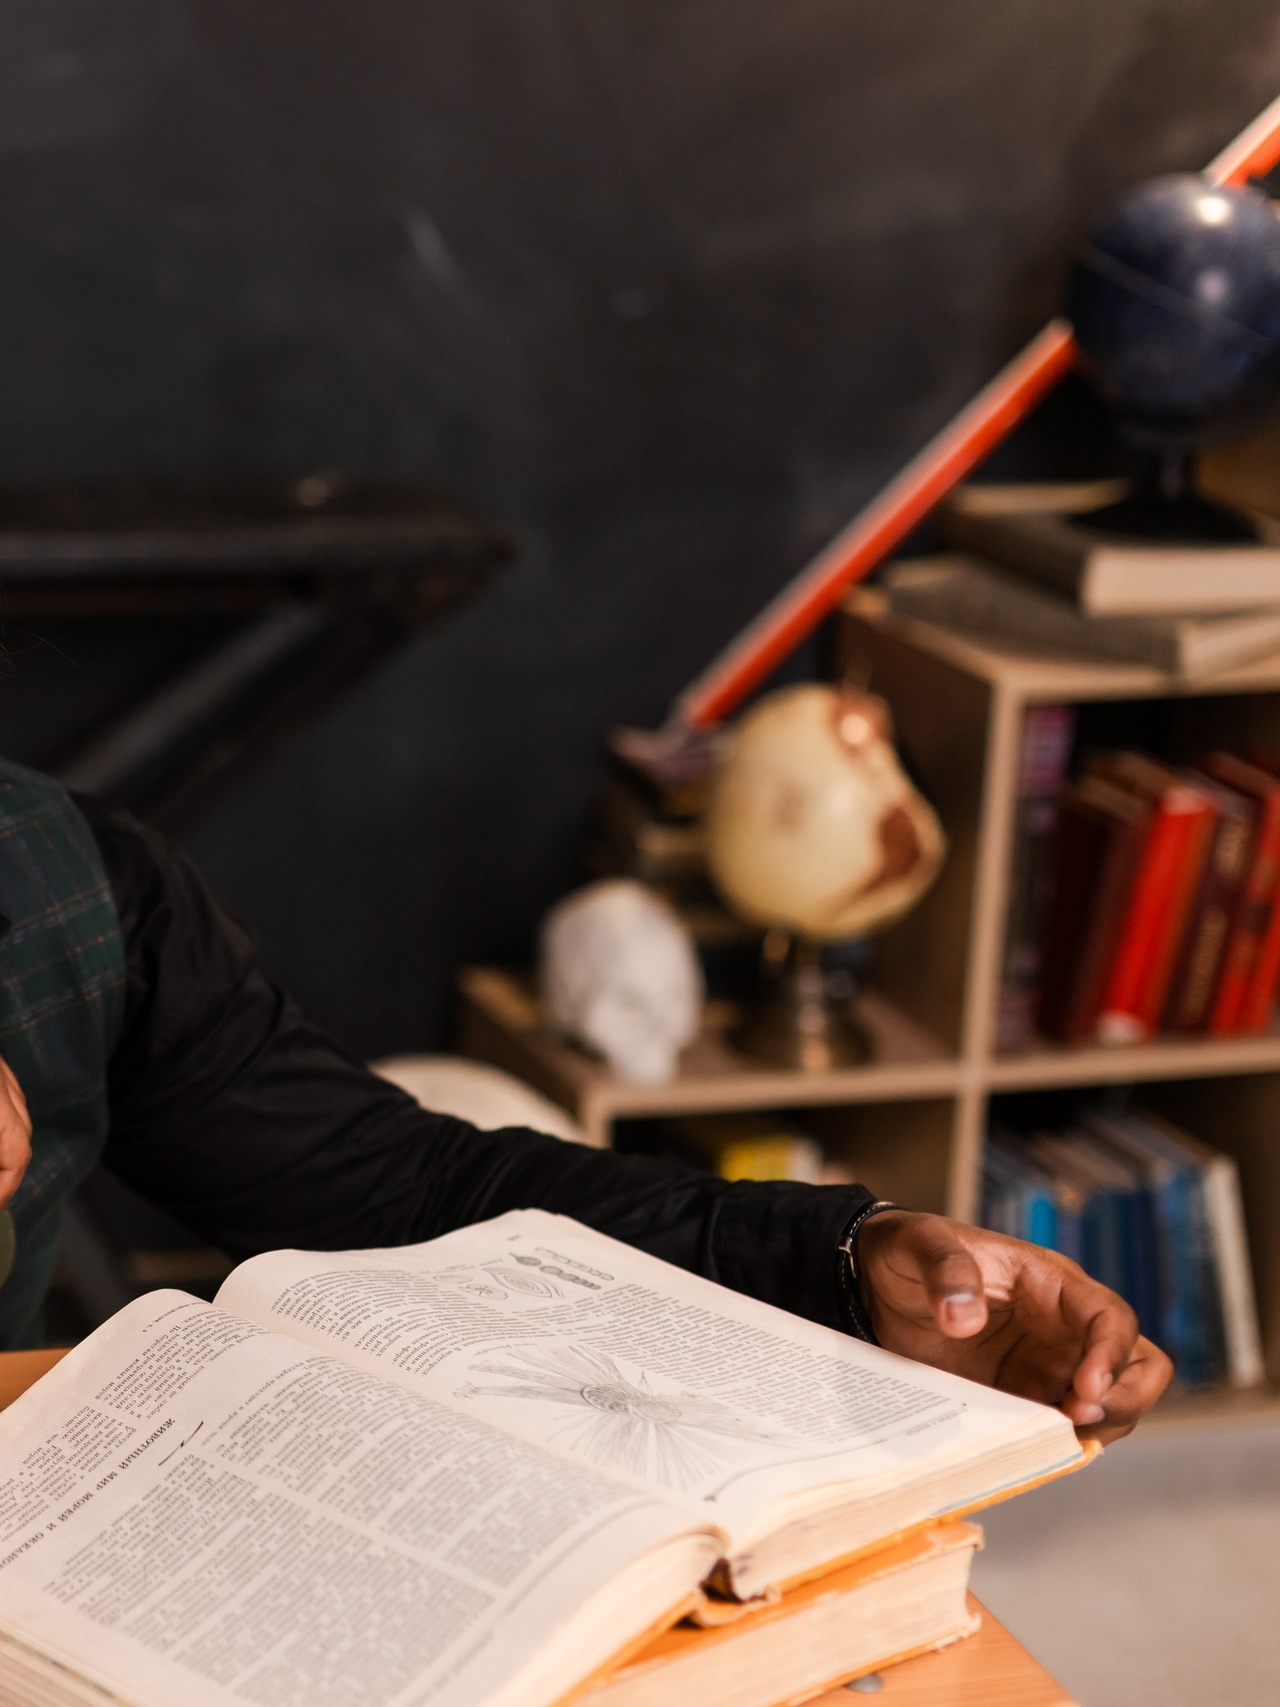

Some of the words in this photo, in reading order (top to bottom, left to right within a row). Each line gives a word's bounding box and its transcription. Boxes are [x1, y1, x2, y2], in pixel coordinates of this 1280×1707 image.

[140, 1332, 169, 1358] берегам
[154, 1341, 179, 1363] льдами
[155, 1331, 180, 1352] только
[181, 1346, 194, 1358] его
[183, 1340, 211, 1364] дремлет
[162, 1344, 186, 1365] севере
[192, 1347, 215, 1367] всегда
[111, 1350, 156, 1393] призрачными
[115, 1357, 140, 1380] южных
[143, 1363, 163, 1383] почти
[175, 1363, 206, 1392] который
[92, 1378, 116, 1401] морей
[106, 1369, 146, 1407] освещаются
[135, 1362, 176, 1400] бушующую
[152, 1369, 188, 1403] прекрасно
[153, 1371, 176, 1393] ясный
[101, 1392, 113, 1403] се-
[113, 1381, 145, 1411] круглый
[121, 1397, 137, 1413] сти-
[134, 1392, 153, 1410] день
[92, 1413, 110, 1430] гово
[102, 1416, 117, 1431] нов
[103, 1425, 117, 1439] они
[44, 1431, 59, 1445] чем
[63, 1428, 103, 1465] квадратных
[101, 1429, 123, 1450] одних
[113, 1425, 137, 1449] растут
[117, 1416, 176, 1471] ЖИВОТНЫЙ
[25, 1442, 57, 1471] Глубина
[77, 1450, 101, 1472] морей
[86, 1449, 113, 1474] пальмы
[39, 1466, 71, 1494] площадь
[46, 1470, 78, 1498] глубина
[52, 1479, 78, 1502] цветут
[94, 1469, 118, 1492] МИР
[57, 1490, 94, 1523] МОРЕЙ
[45, 1521, 57, 1532] И
